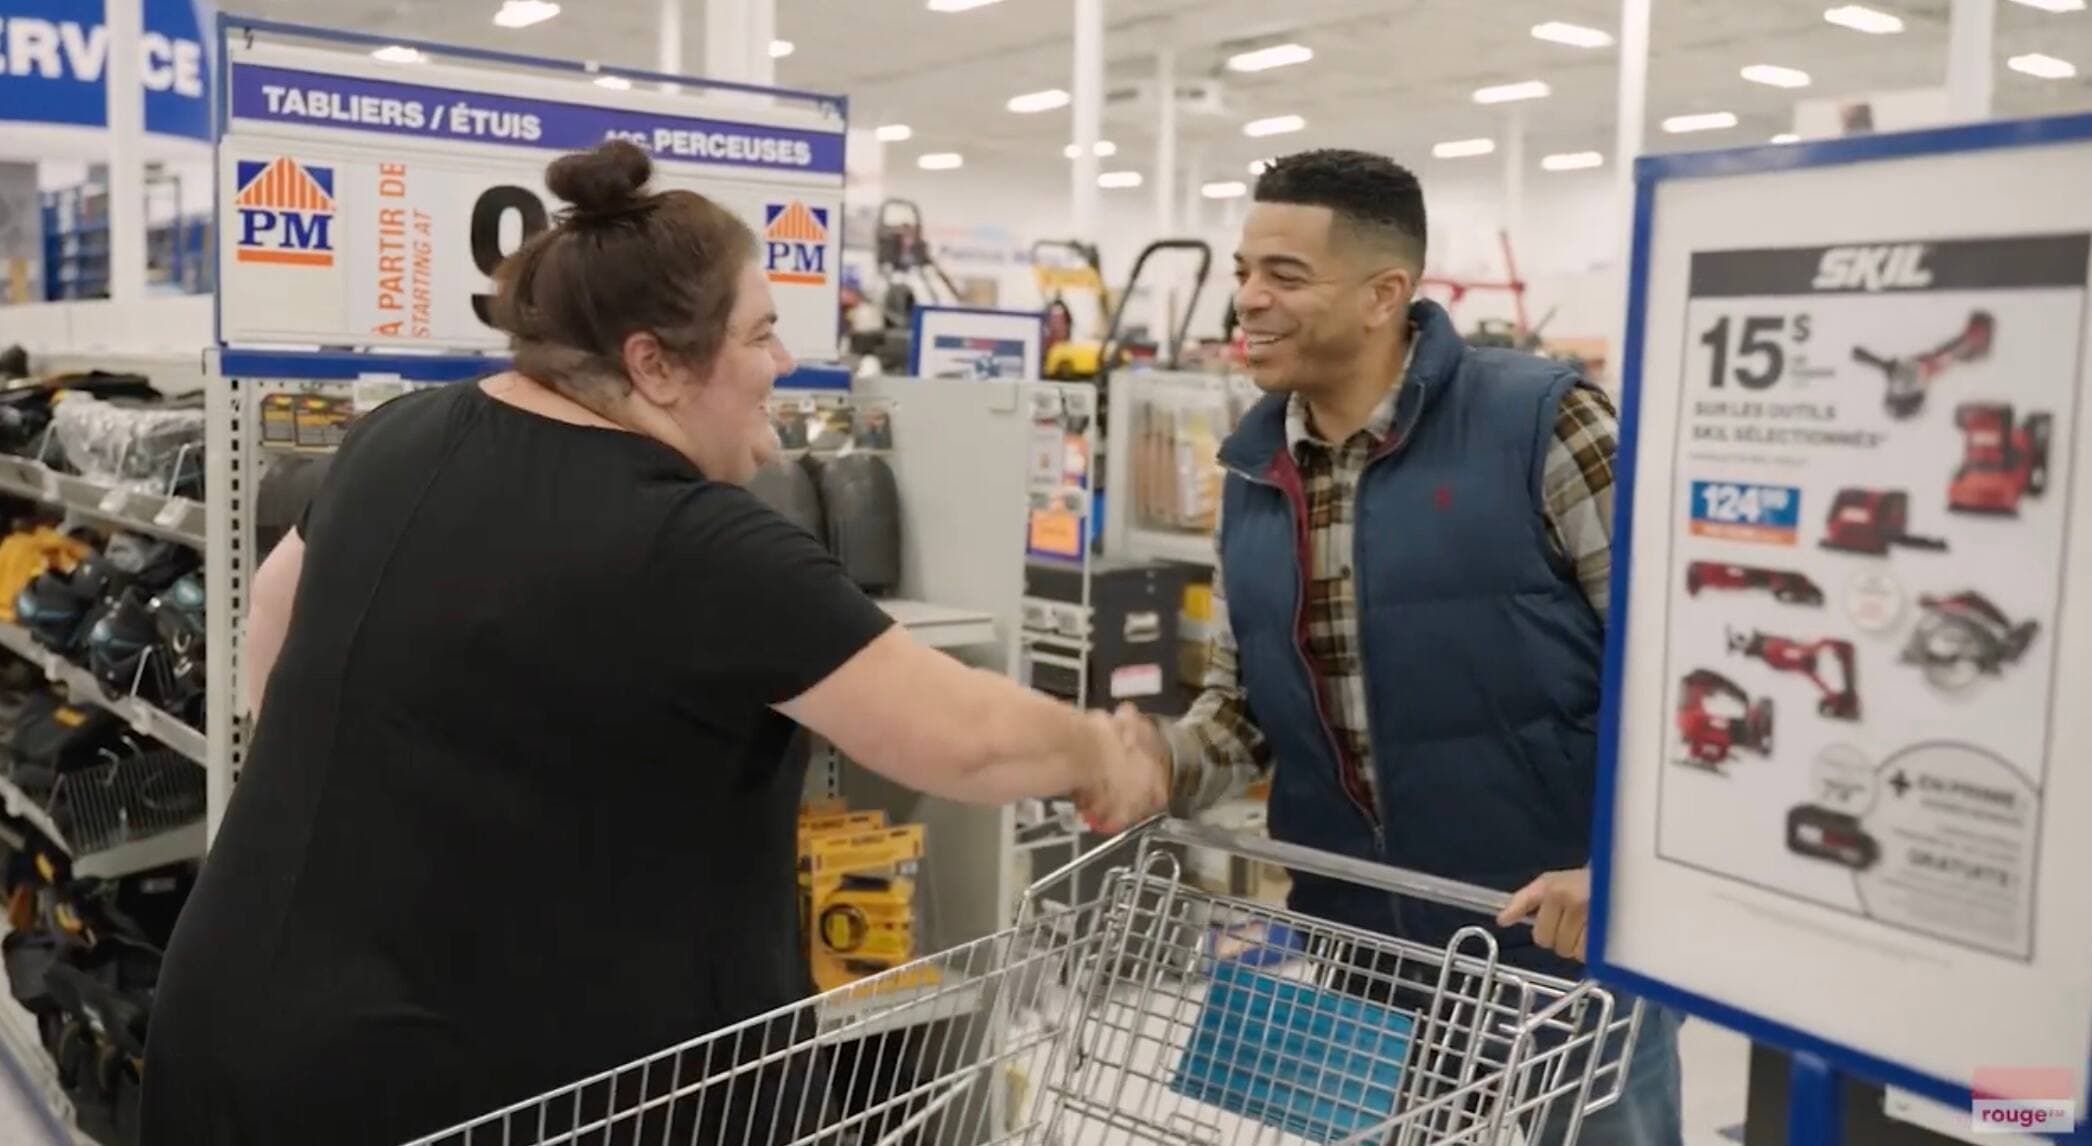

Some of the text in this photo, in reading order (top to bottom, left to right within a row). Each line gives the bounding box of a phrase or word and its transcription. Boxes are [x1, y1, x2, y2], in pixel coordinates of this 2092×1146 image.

[0, 17, 203, 98] RVCE
[261, 85, 425, 128] TABLIERS
[450, 102, 542, 140] ÉTUIS
[653, 128, 812, 165] PERCEUSES
[379, 163, 405, 198] DE
[237, 208, 333, 250] PM
[379, 208, 405, 310] PARTIR
[765, 241, 826, 273] PM
[411, 208, 431, 337] STARTING AT
[1812, 244, 1934, 291] SKIL
